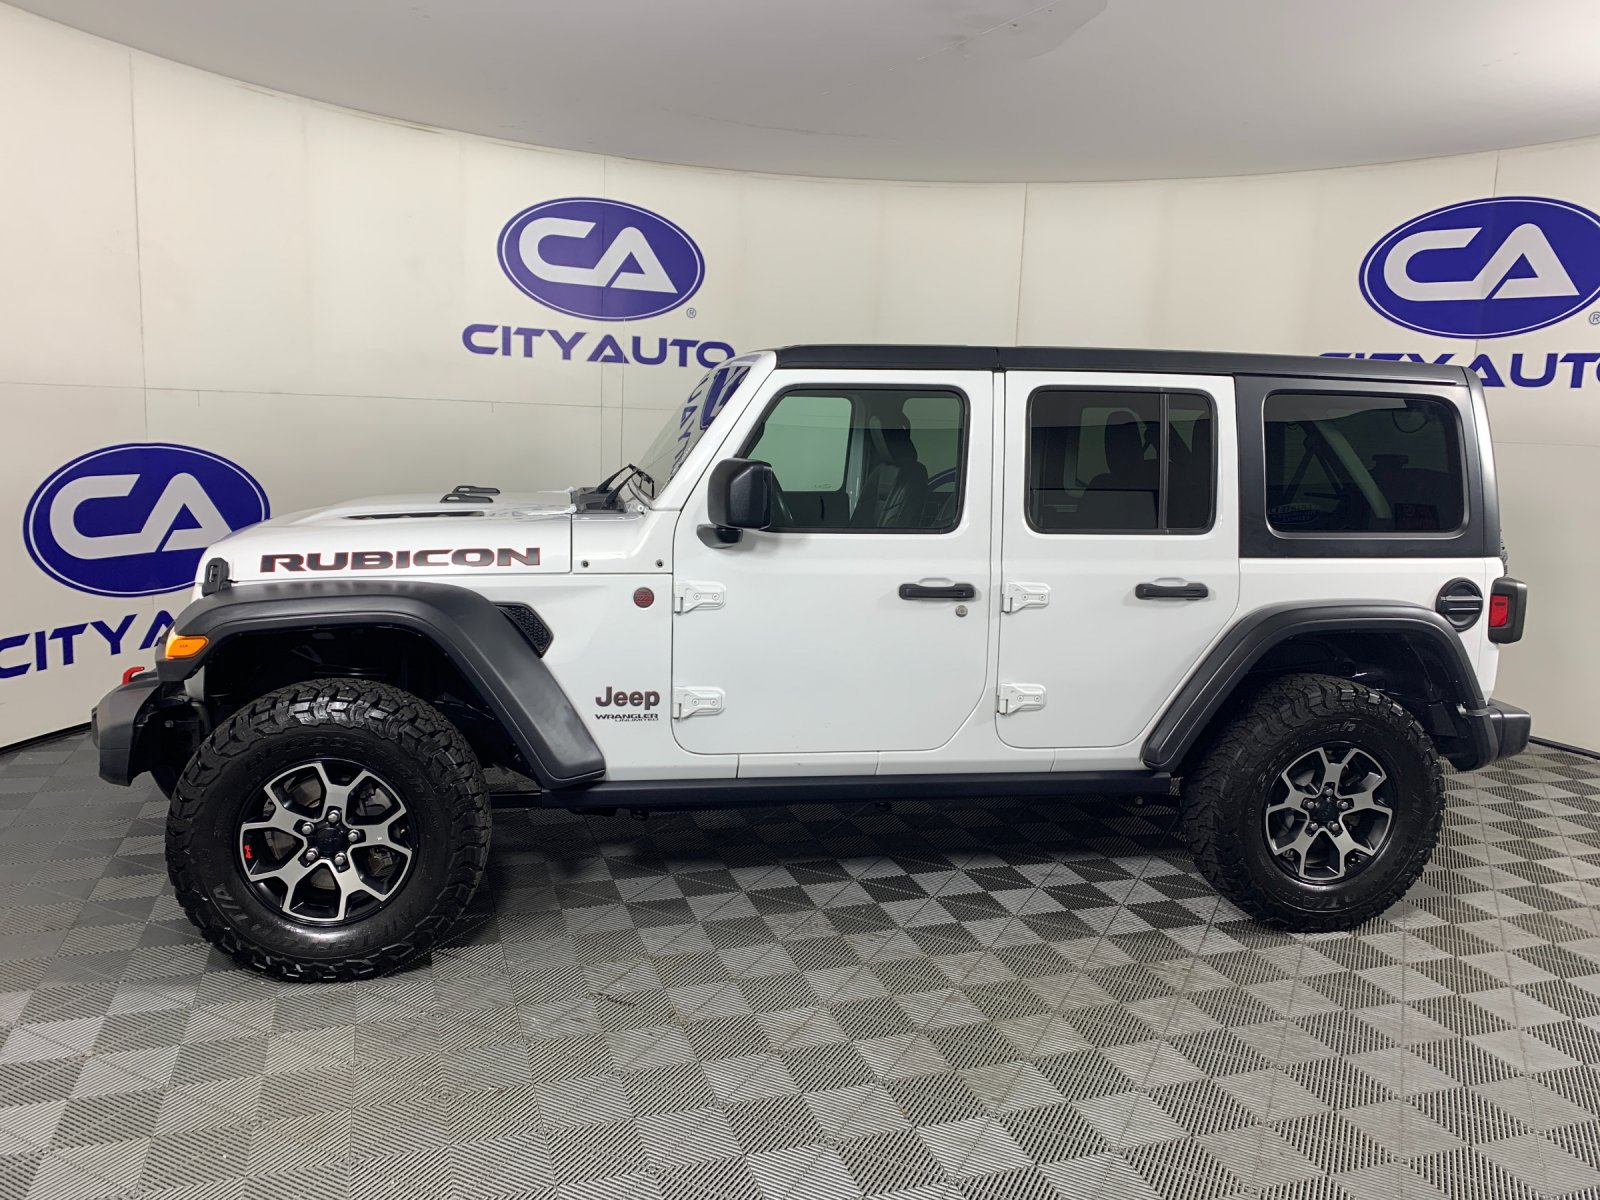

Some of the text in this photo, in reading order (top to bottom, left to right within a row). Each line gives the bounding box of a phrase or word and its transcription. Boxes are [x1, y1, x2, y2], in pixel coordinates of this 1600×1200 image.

[518, 216, 679, 294] CA
[1383, 222, 1581, 302] CA
[462, 323, 736, 369] CITY AUTO
[1467, 352, 1600, 389] AUT
[49, 471, 234, 560] CA
[259, 547, 541, 573] RUBICON
[595, 686, 660, 711] Jeep
